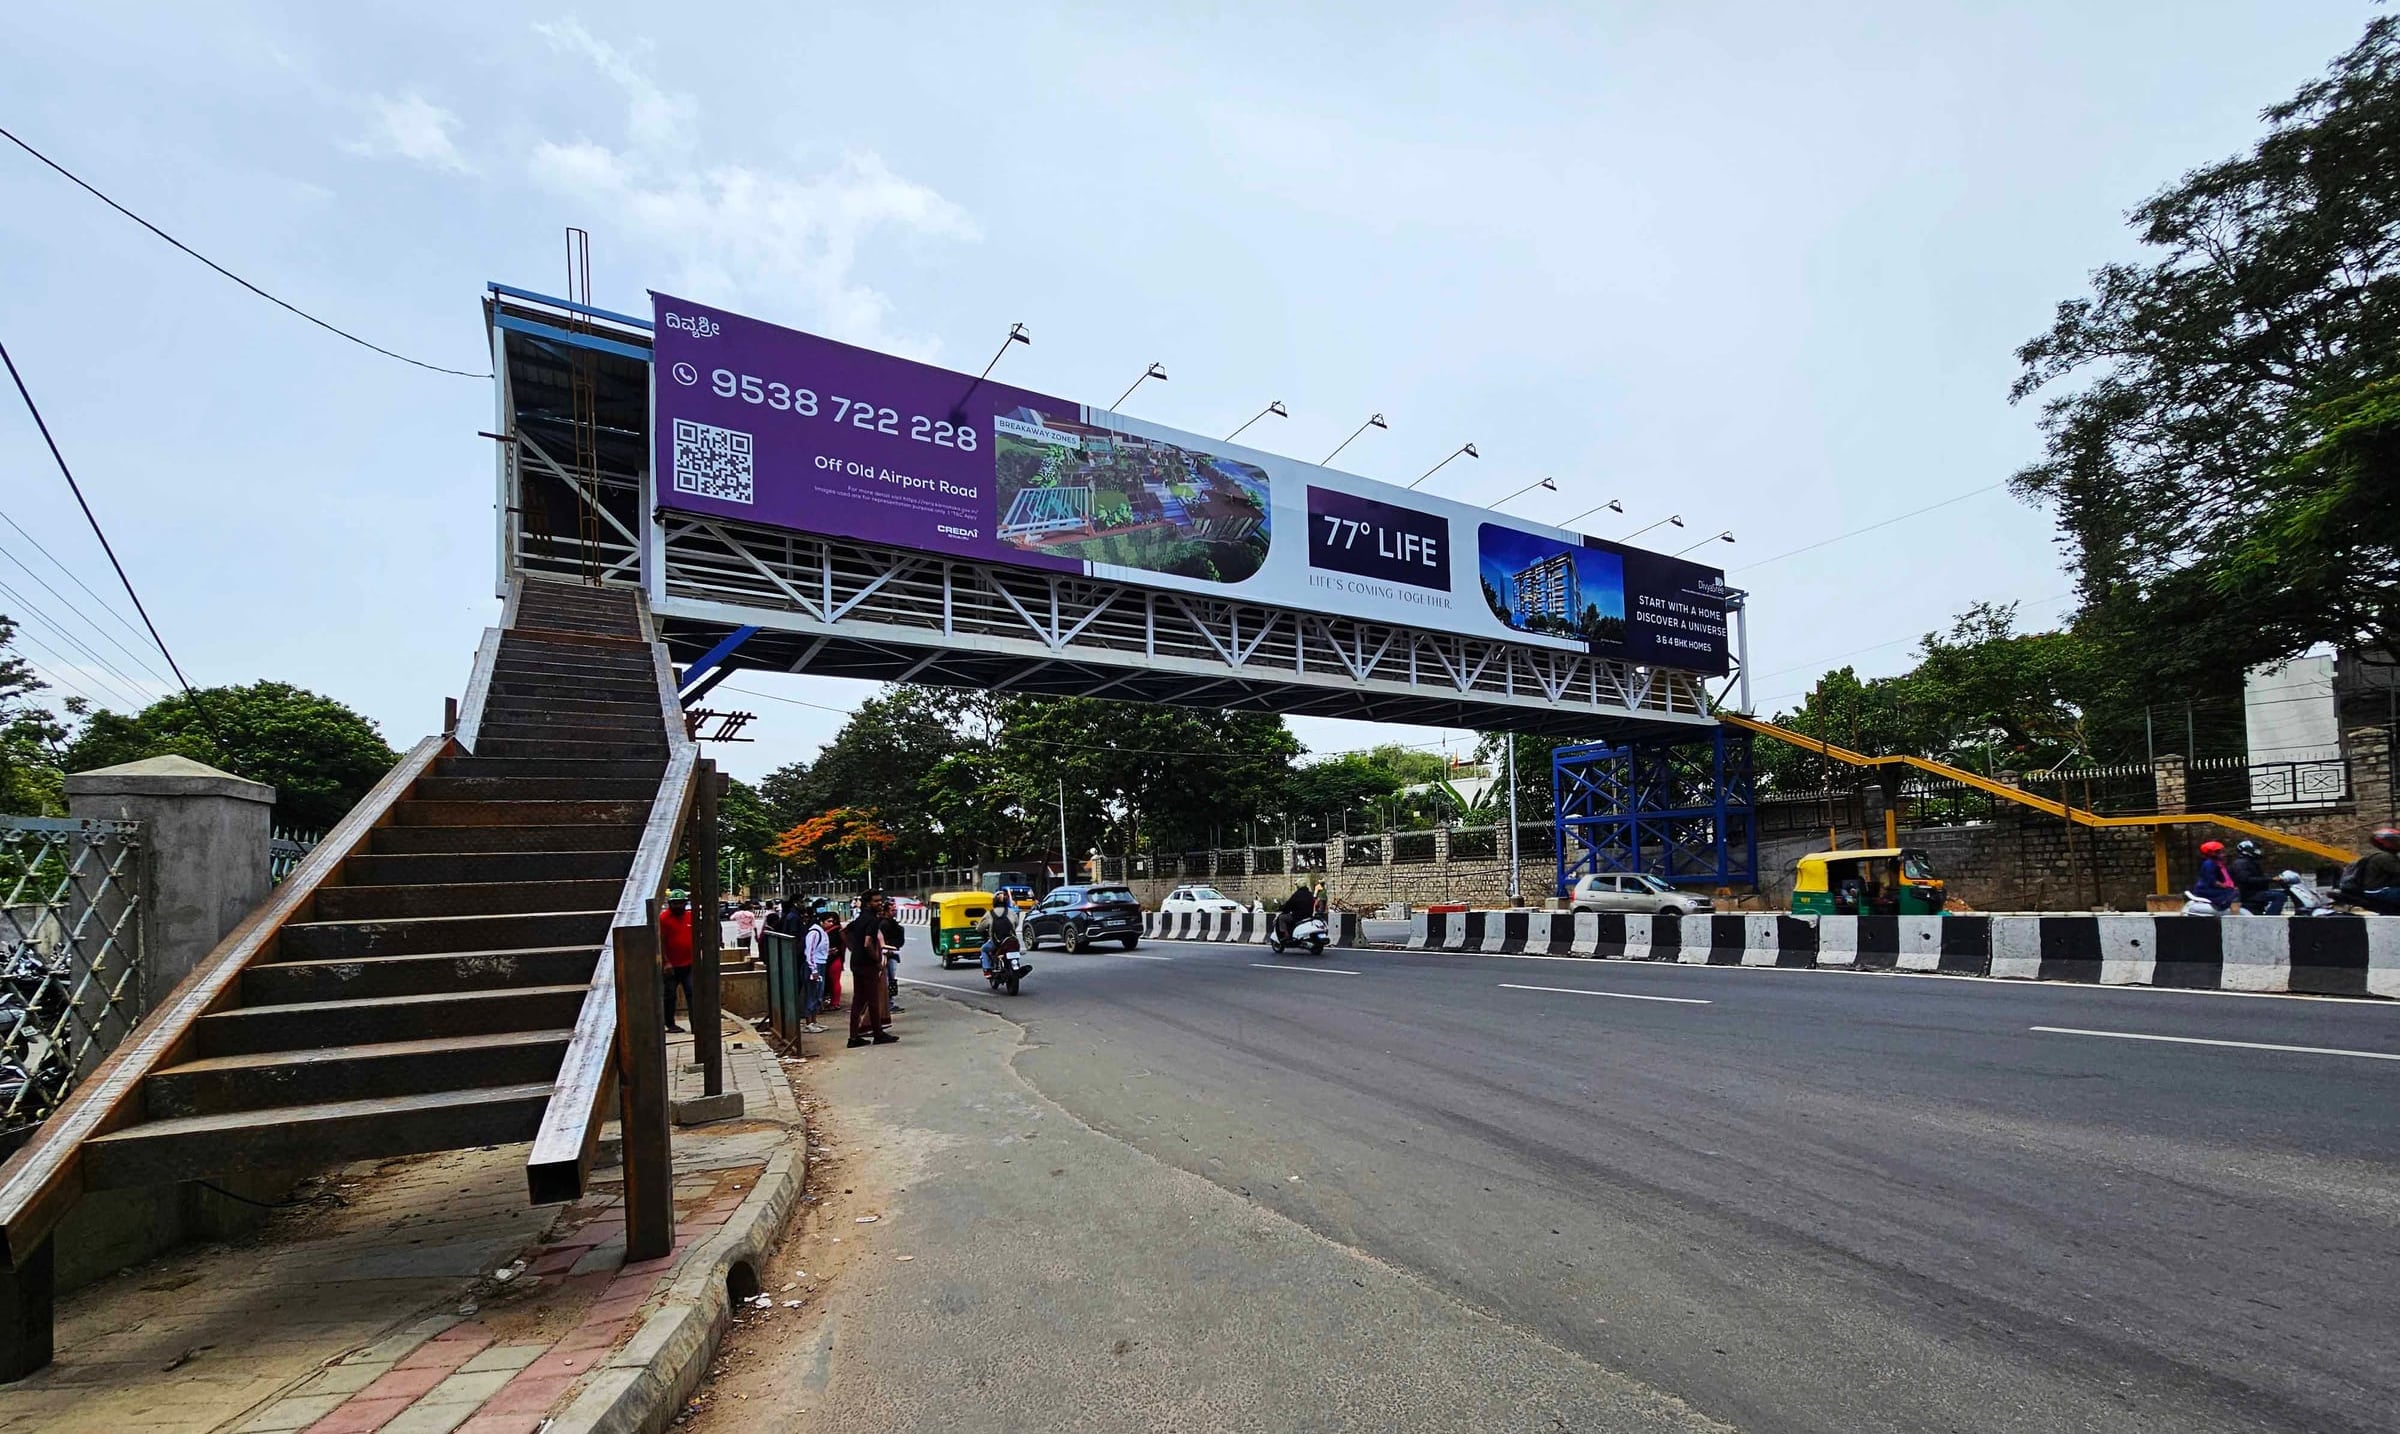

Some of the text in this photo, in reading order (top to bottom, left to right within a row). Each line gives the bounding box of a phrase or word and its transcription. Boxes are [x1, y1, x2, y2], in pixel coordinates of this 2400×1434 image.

[665, 312, 720, 338] ದಿವ್ಯಶ್ರೀ
[711, 369, 978, 452] 9538 722 228
[999, 419, 1077, 445] BREAKAWAY ZONES
[814, 455, 977, 499] Off Old Airport Road
[1324, 515, 1437, 567] 77° LIFE
[1309, 575, 1452, 610] LIFE'S COMING TOGETHER.
[1639, 595, 1666, 609] START
[1667, 601, 1689, 614] WITH
[1690, 606, 1697, 616] A
[1636, 611, 1727, 637] DISCOVER A UNIVERSE
[1656, 634, 1662, 643] 3
[1668, 637, 1674, 646] 4
[1674, 638, 1688, 648] BHK
[1688, 641, 1712, 652] HOMES
